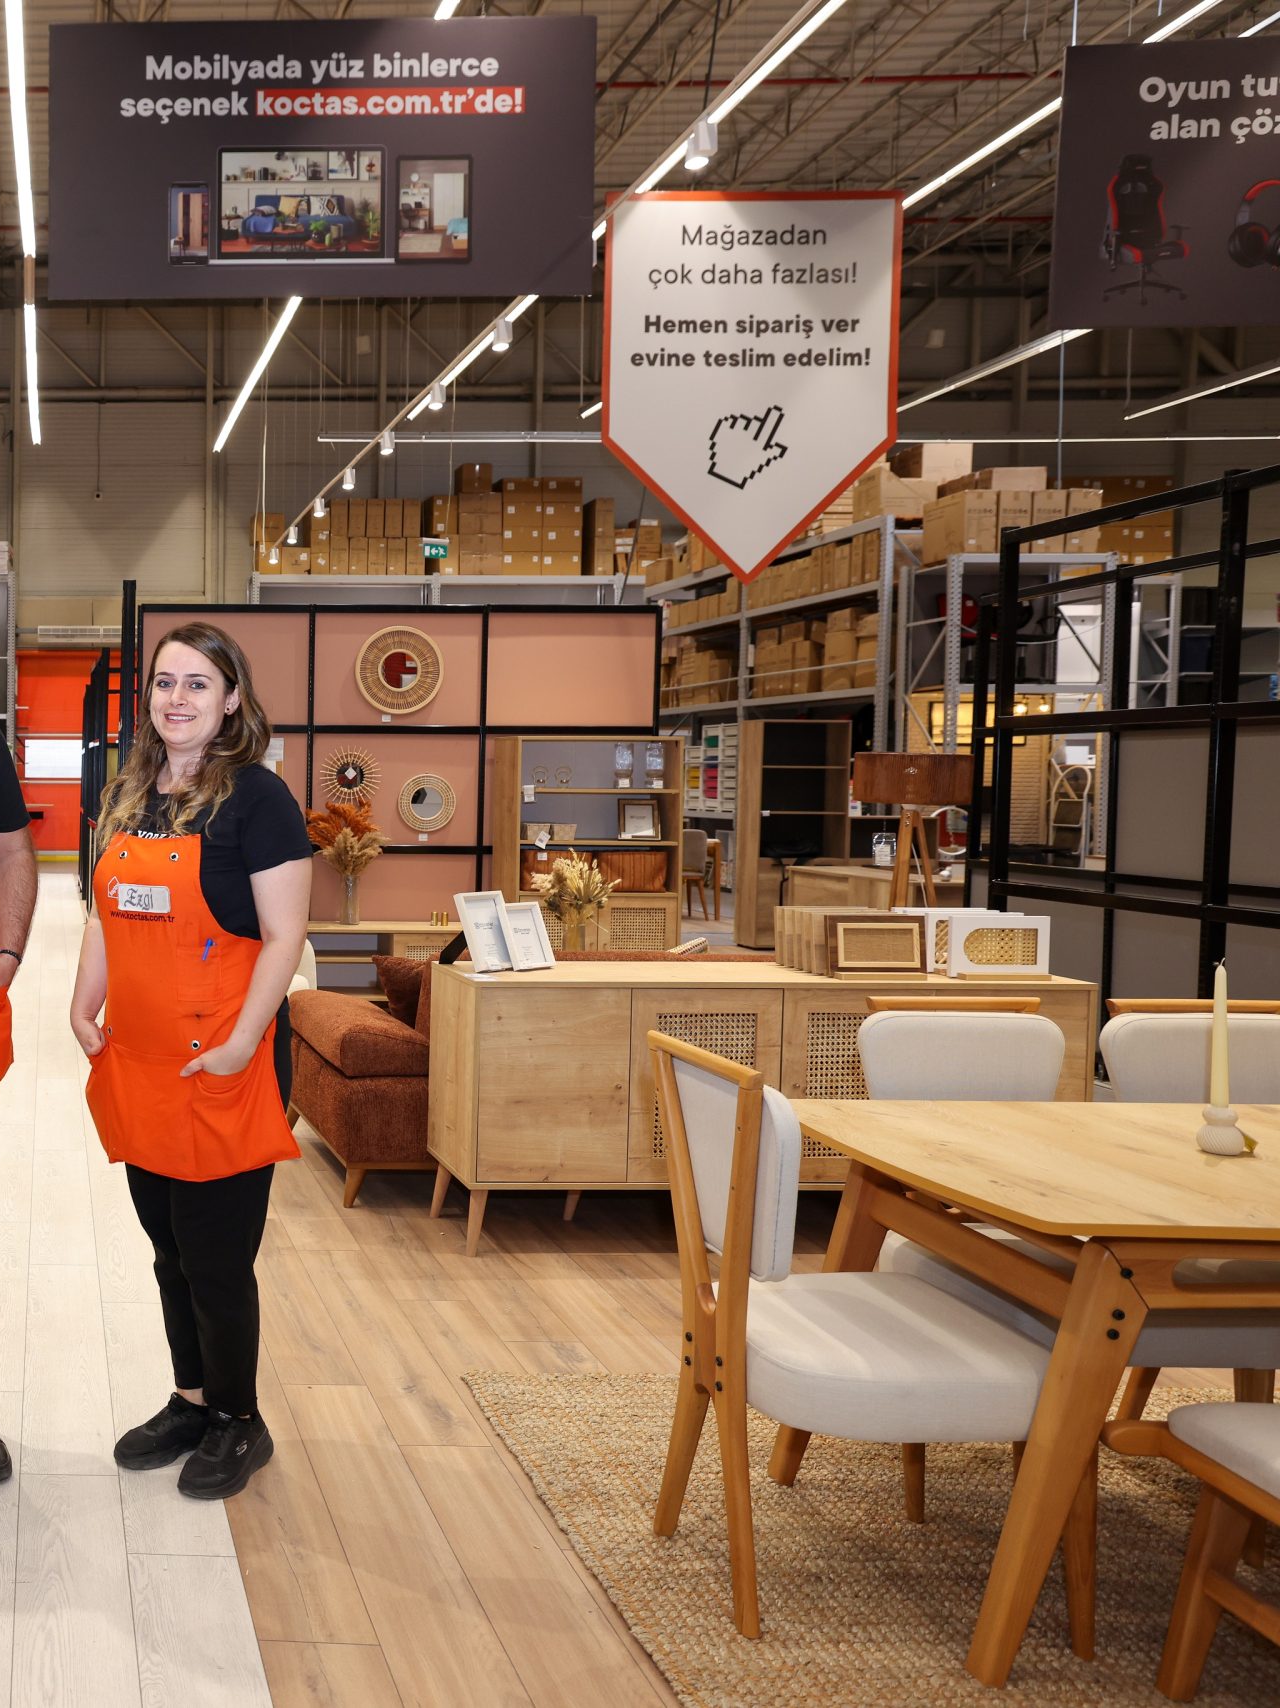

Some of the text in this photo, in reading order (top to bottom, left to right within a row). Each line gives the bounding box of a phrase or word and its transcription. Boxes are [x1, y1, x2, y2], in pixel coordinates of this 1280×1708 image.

[145, 52, 499, 85] Mobilyada yüz binlerce
[1139, 74, 1280, 108] Oyun tu
[120, 87, 523, 124] seçenek koctas.com.tr’de!
[1150, 113, 1221, 141] alan
[681, 223, 828, 251] Mağazadan
[648, 261, 858, 290] çok daha fazlası!
[644, 314, 860, 339] Hemen sipariş ver
[630, 347, 871, 367] evine teslim edelim!
[123, 887, 154, 911] Ezgi
[110, 910, 176, 923] www.koctas.com.tr
